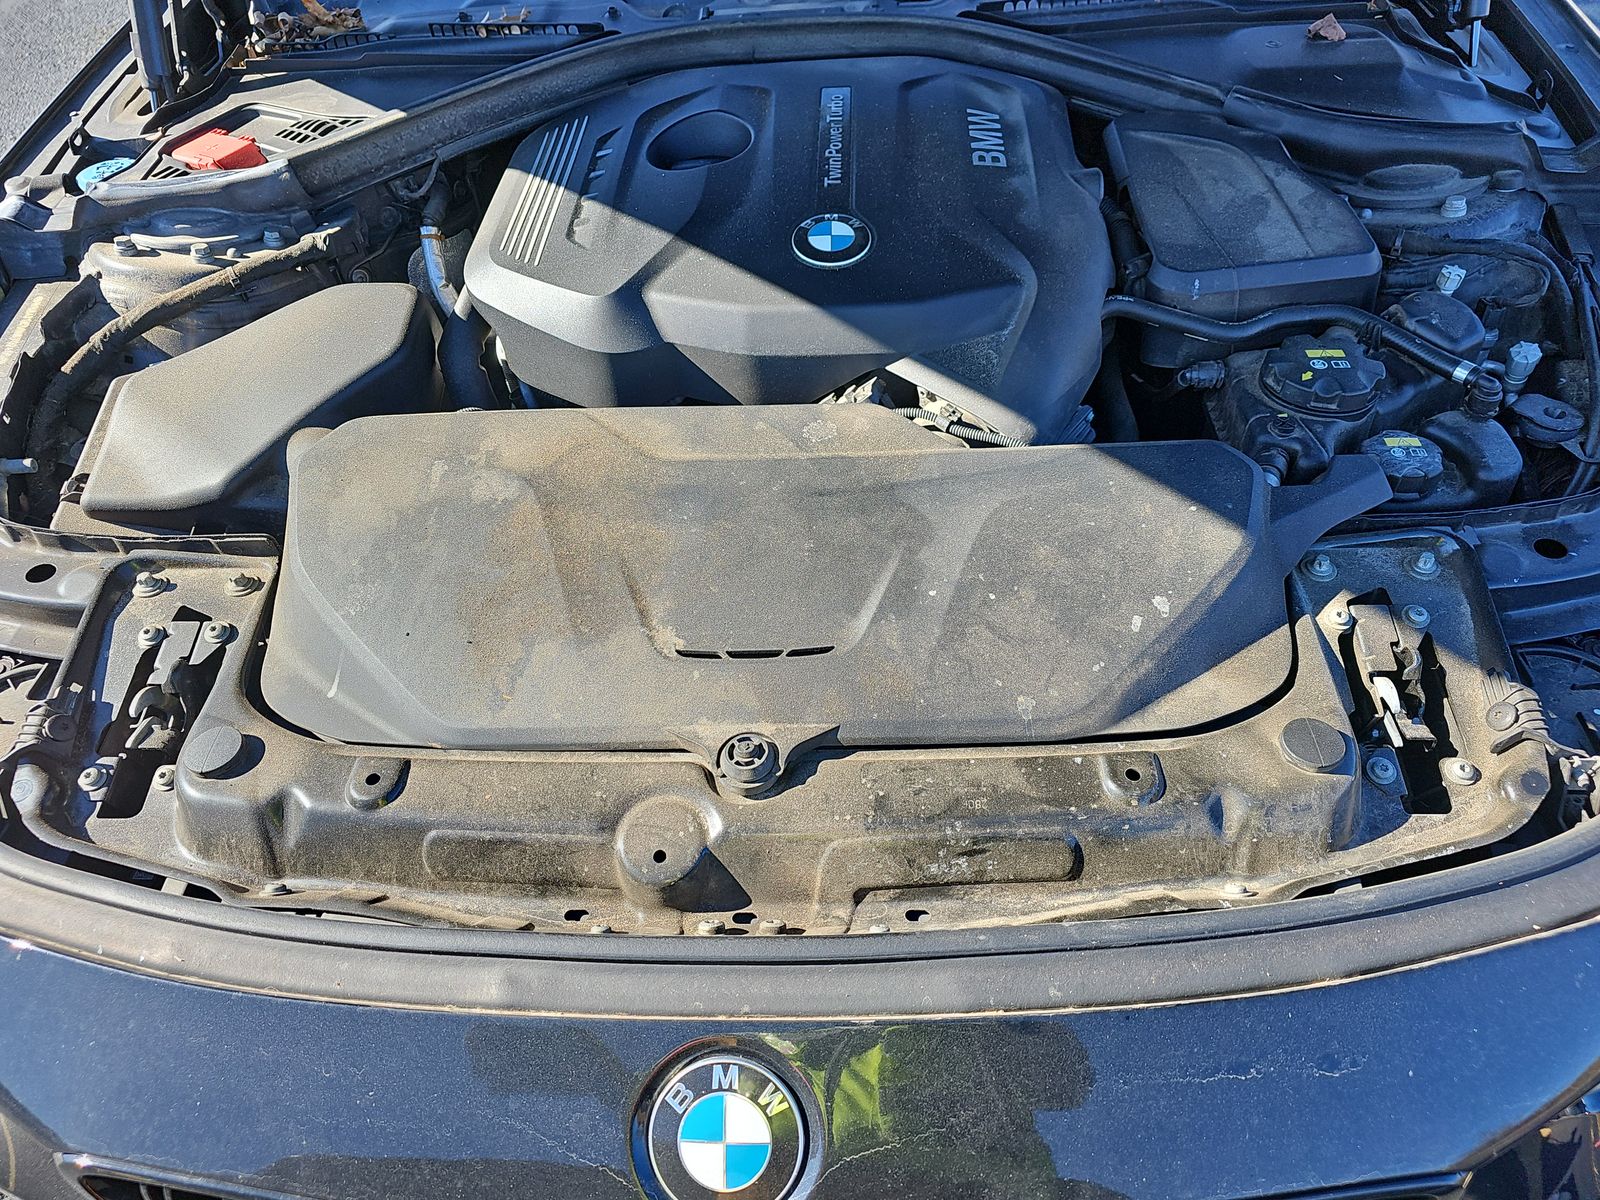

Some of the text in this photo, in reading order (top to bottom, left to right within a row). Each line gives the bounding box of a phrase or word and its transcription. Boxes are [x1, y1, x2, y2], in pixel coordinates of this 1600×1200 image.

[966, 108, 1008, 168] BMW
[800, 213, 864, 229] BMW
[664, 1064, 790, 1118] BMW
